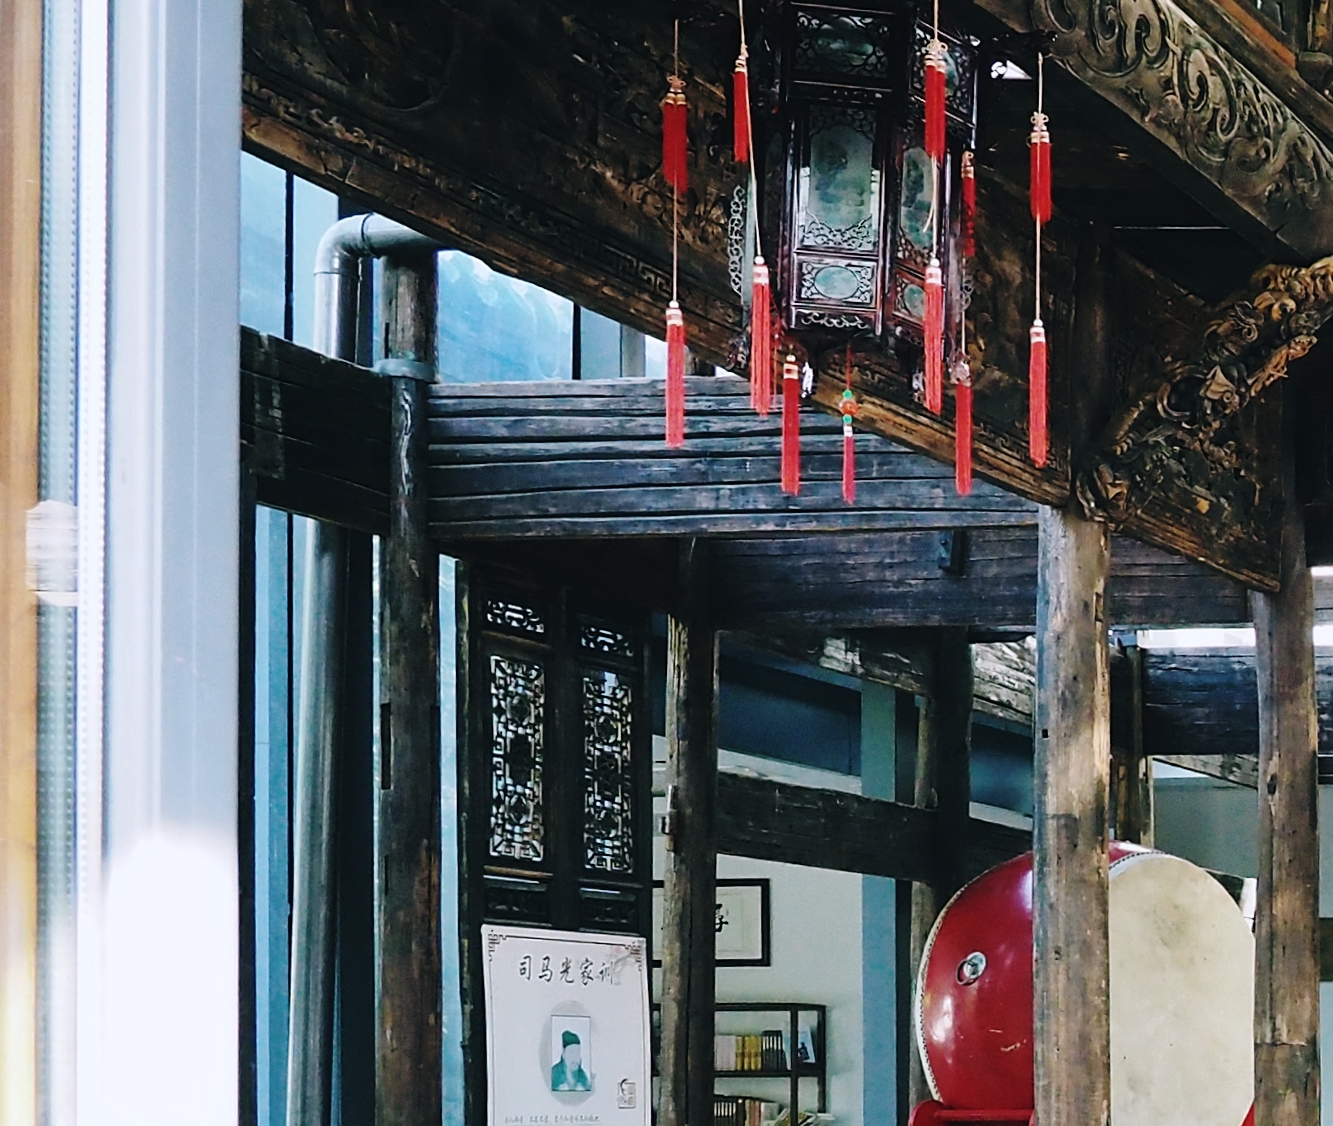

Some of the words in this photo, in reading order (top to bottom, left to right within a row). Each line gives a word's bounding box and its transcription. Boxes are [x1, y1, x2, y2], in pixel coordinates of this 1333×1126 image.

[518, 955, 614, 986] 司马光家训
